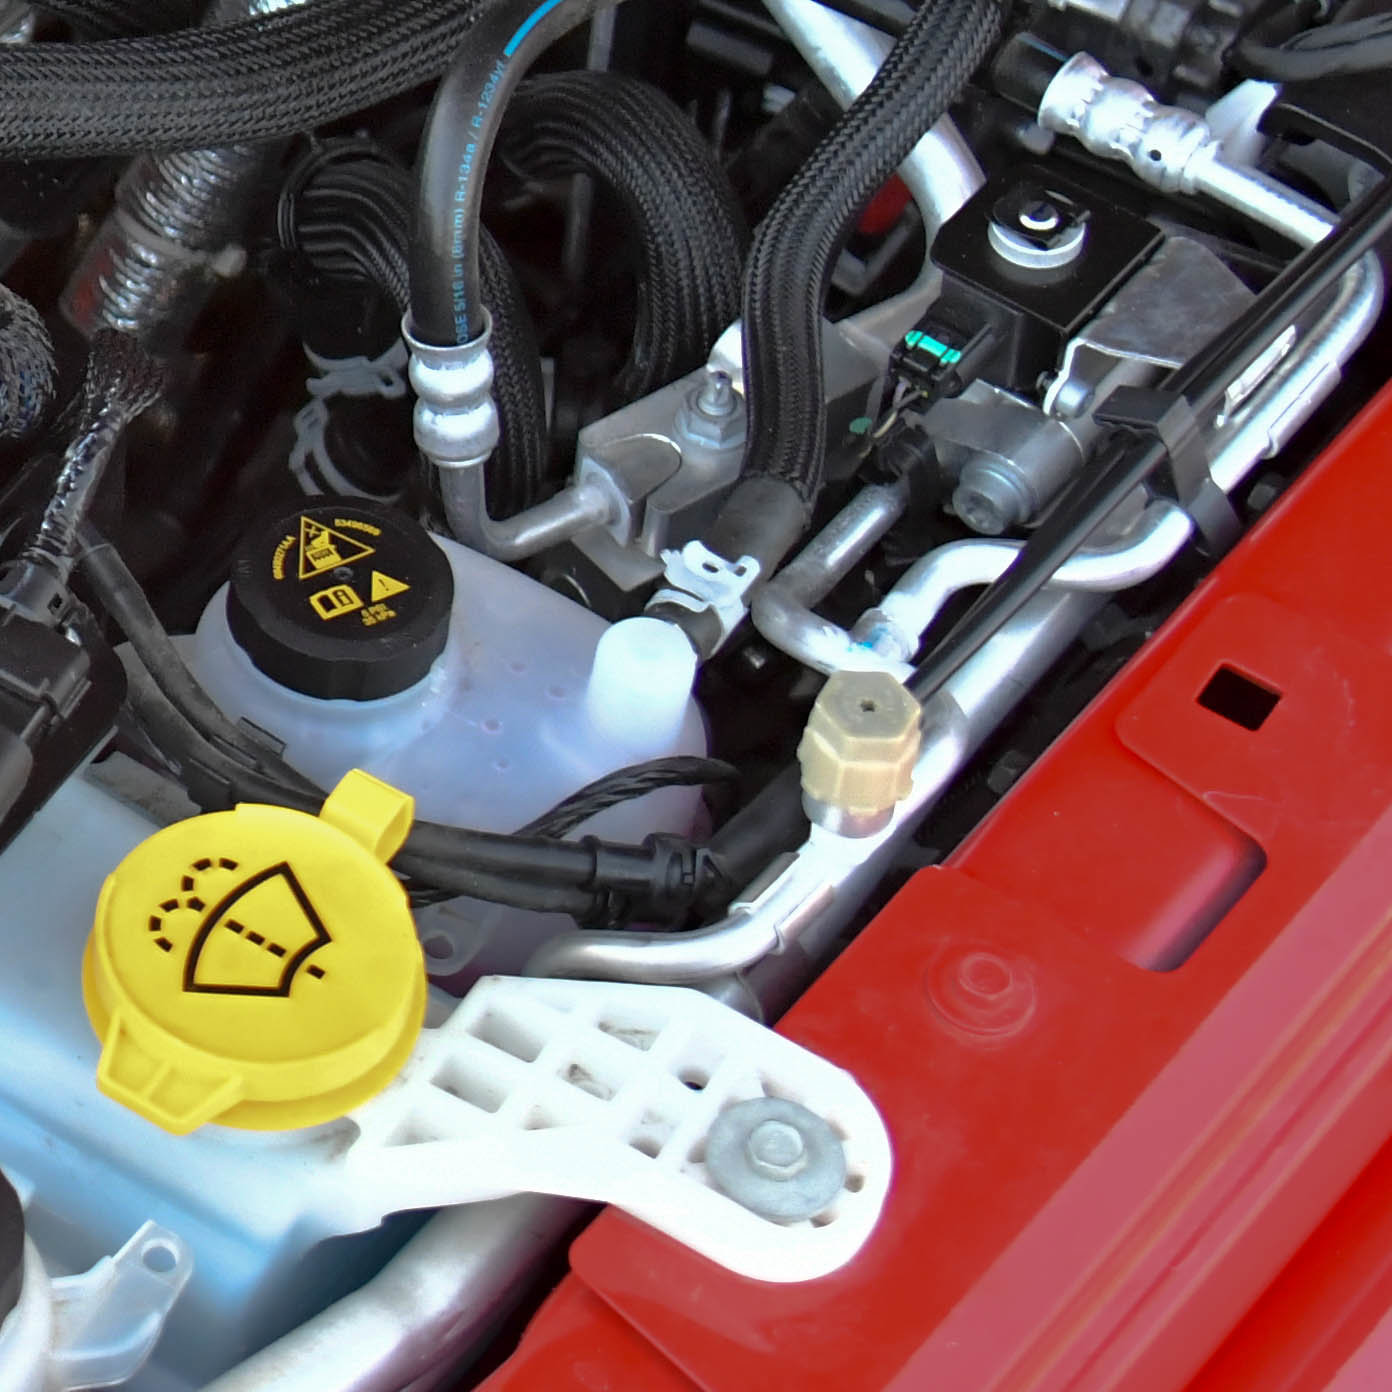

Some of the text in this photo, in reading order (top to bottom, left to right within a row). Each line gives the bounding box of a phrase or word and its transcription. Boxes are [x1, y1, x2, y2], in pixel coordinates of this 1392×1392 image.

[454, 142, 477, 202] R-134a
[453, 263, 464, 278] in
[453, 280, 467, 312] 5/16
